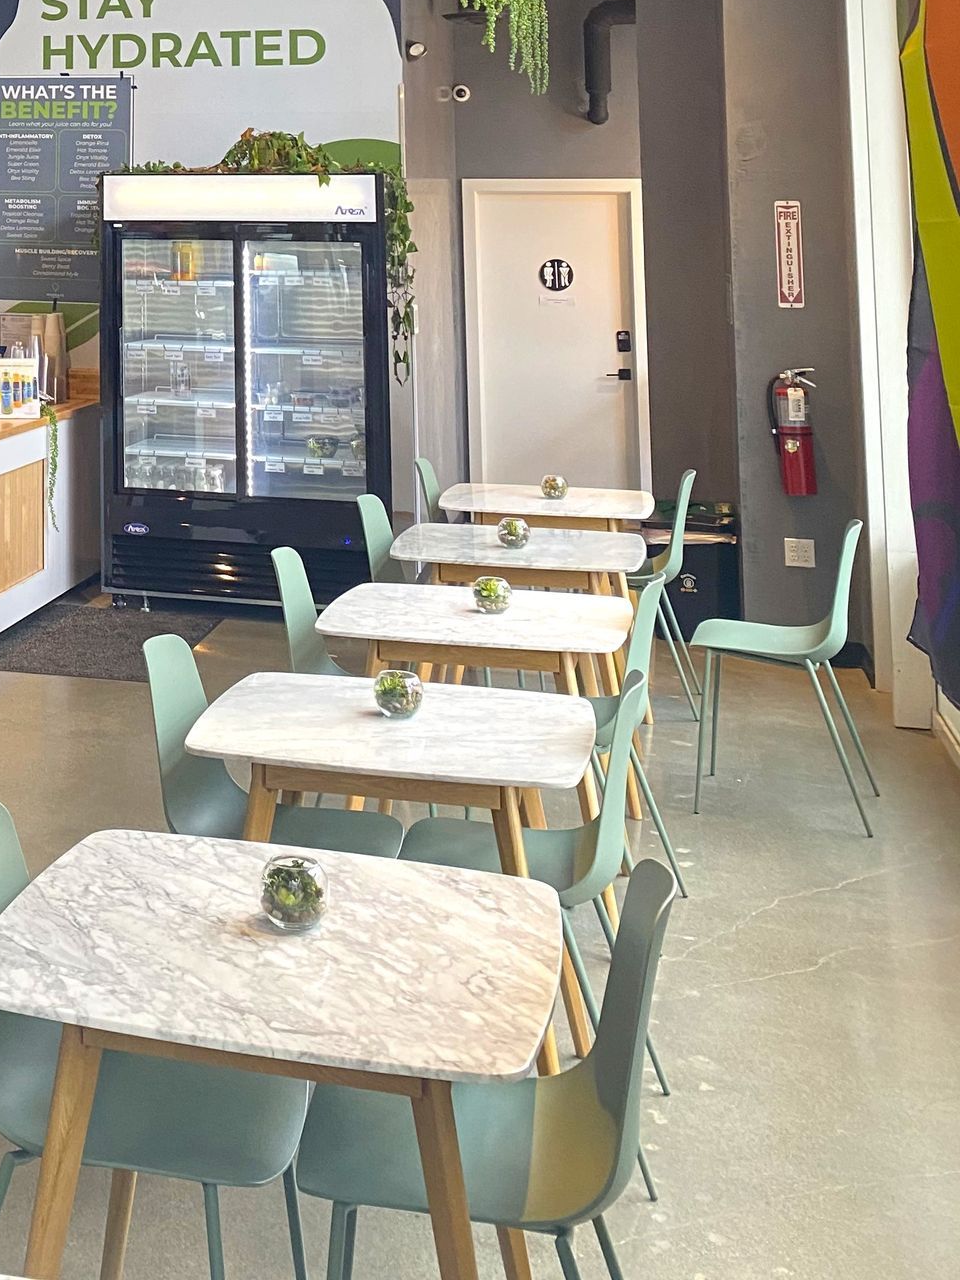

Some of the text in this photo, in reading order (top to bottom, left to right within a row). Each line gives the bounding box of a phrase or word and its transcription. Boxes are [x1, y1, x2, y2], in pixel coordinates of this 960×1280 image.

[42, 29, 326, 70] HYDRATED
[1, 84, 117, 99] WHAT'S THE
[0, 101, 118, 119] BENEFIT?
[779, 211, 797, 220] FIRE
[785, 222, 795, 298] EXTINGUISHER
